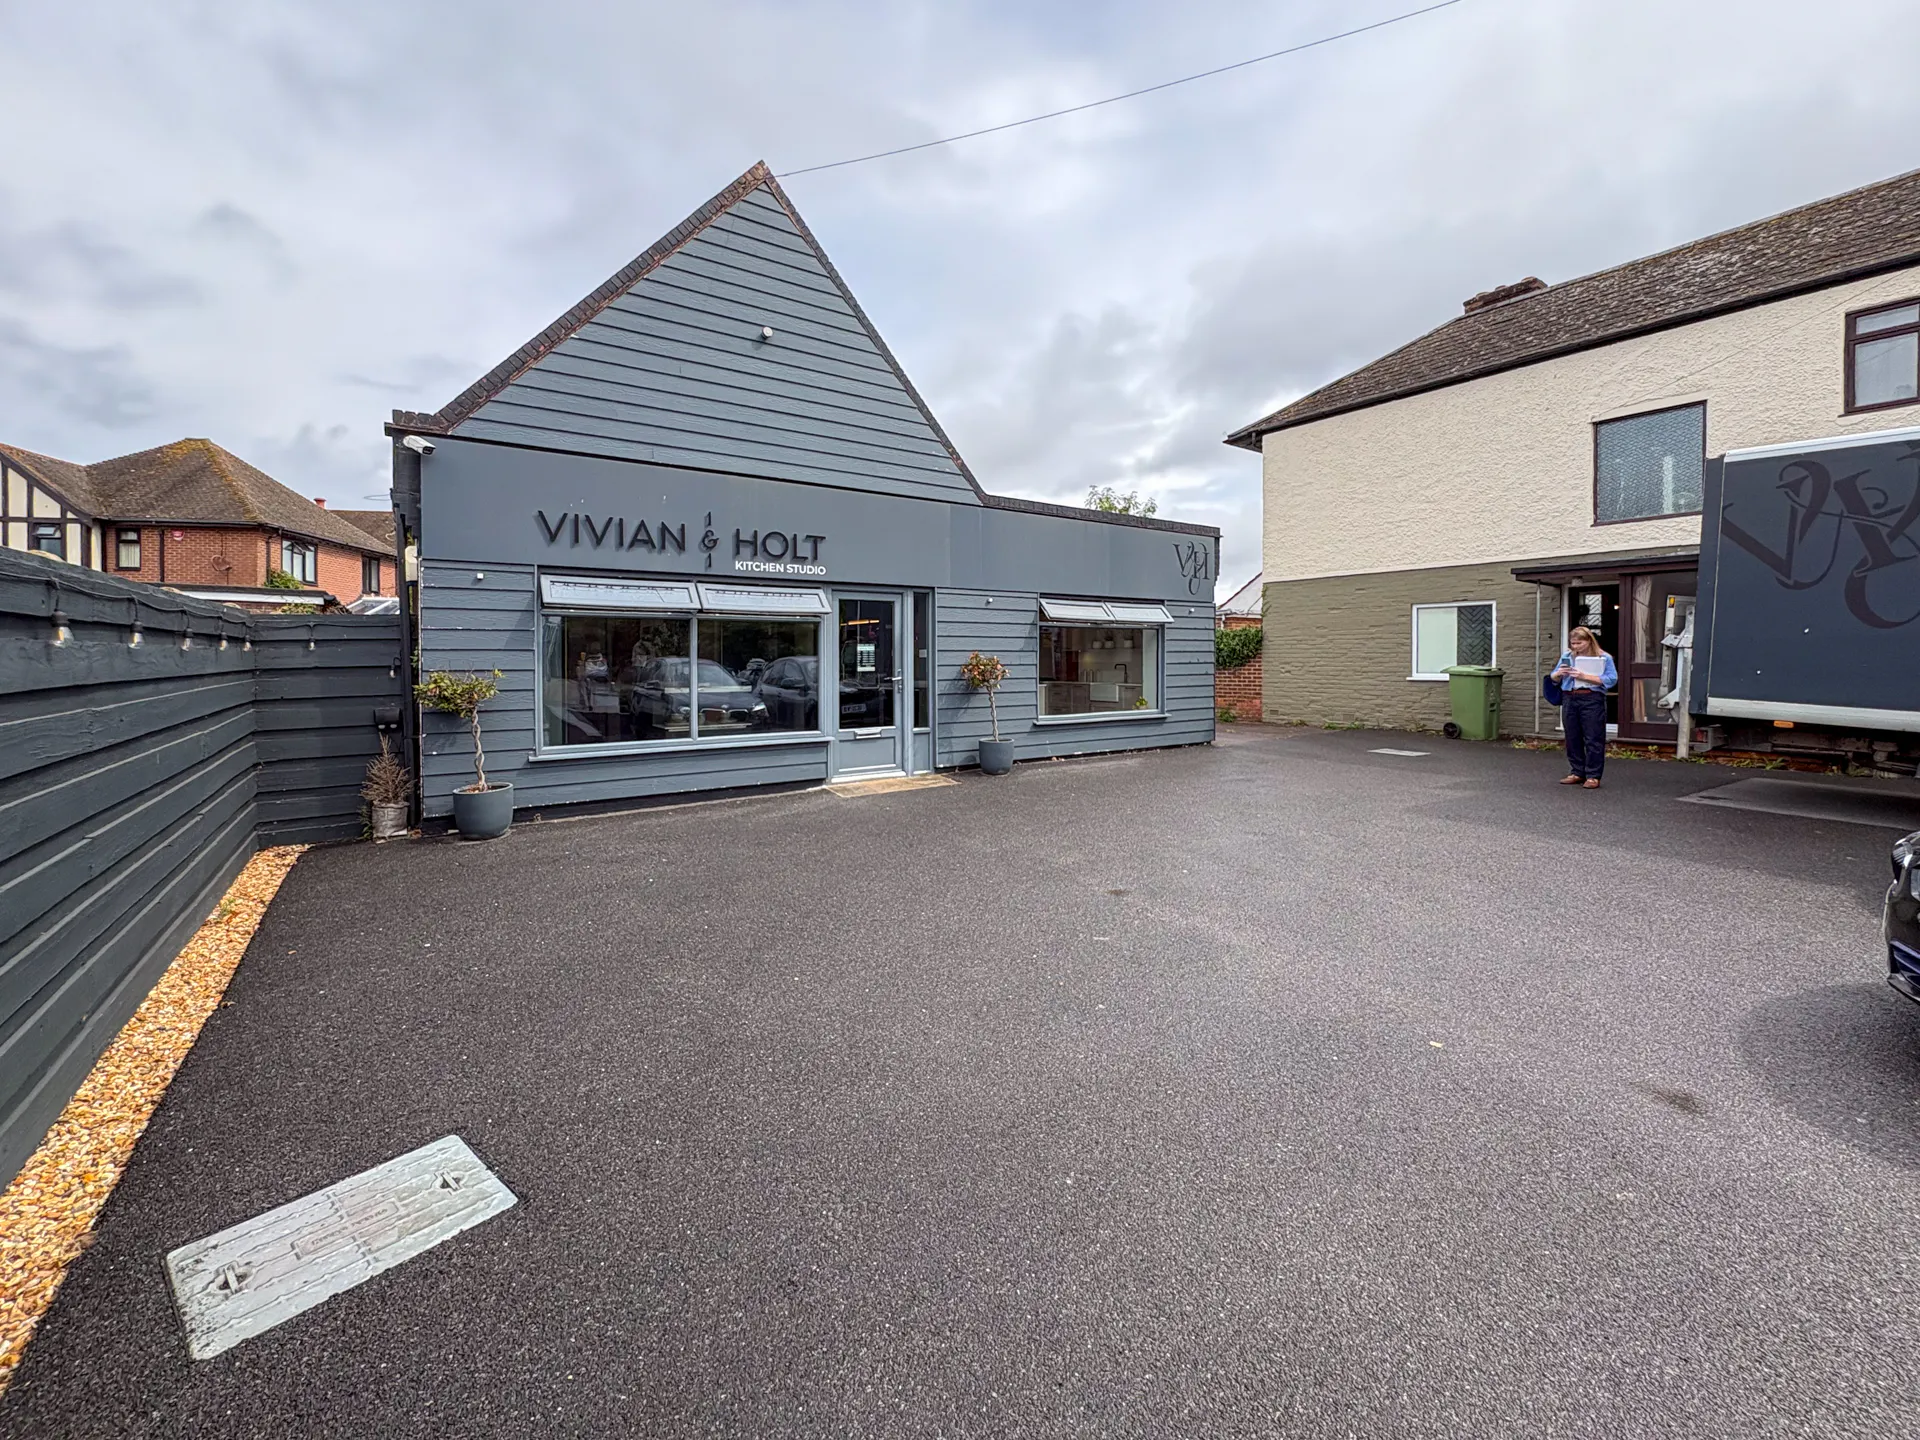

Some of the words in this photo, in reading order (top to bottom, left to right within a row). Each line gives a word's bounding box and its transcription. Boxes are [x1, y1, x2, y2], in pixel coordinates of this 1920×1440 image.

[536, 509, 686, 552] VIVIAN
[735, 527, 827, 561] HOLT
[735, 560, 785, 573] KITCHEN
[786, 564, 827, 576] STUDIO
